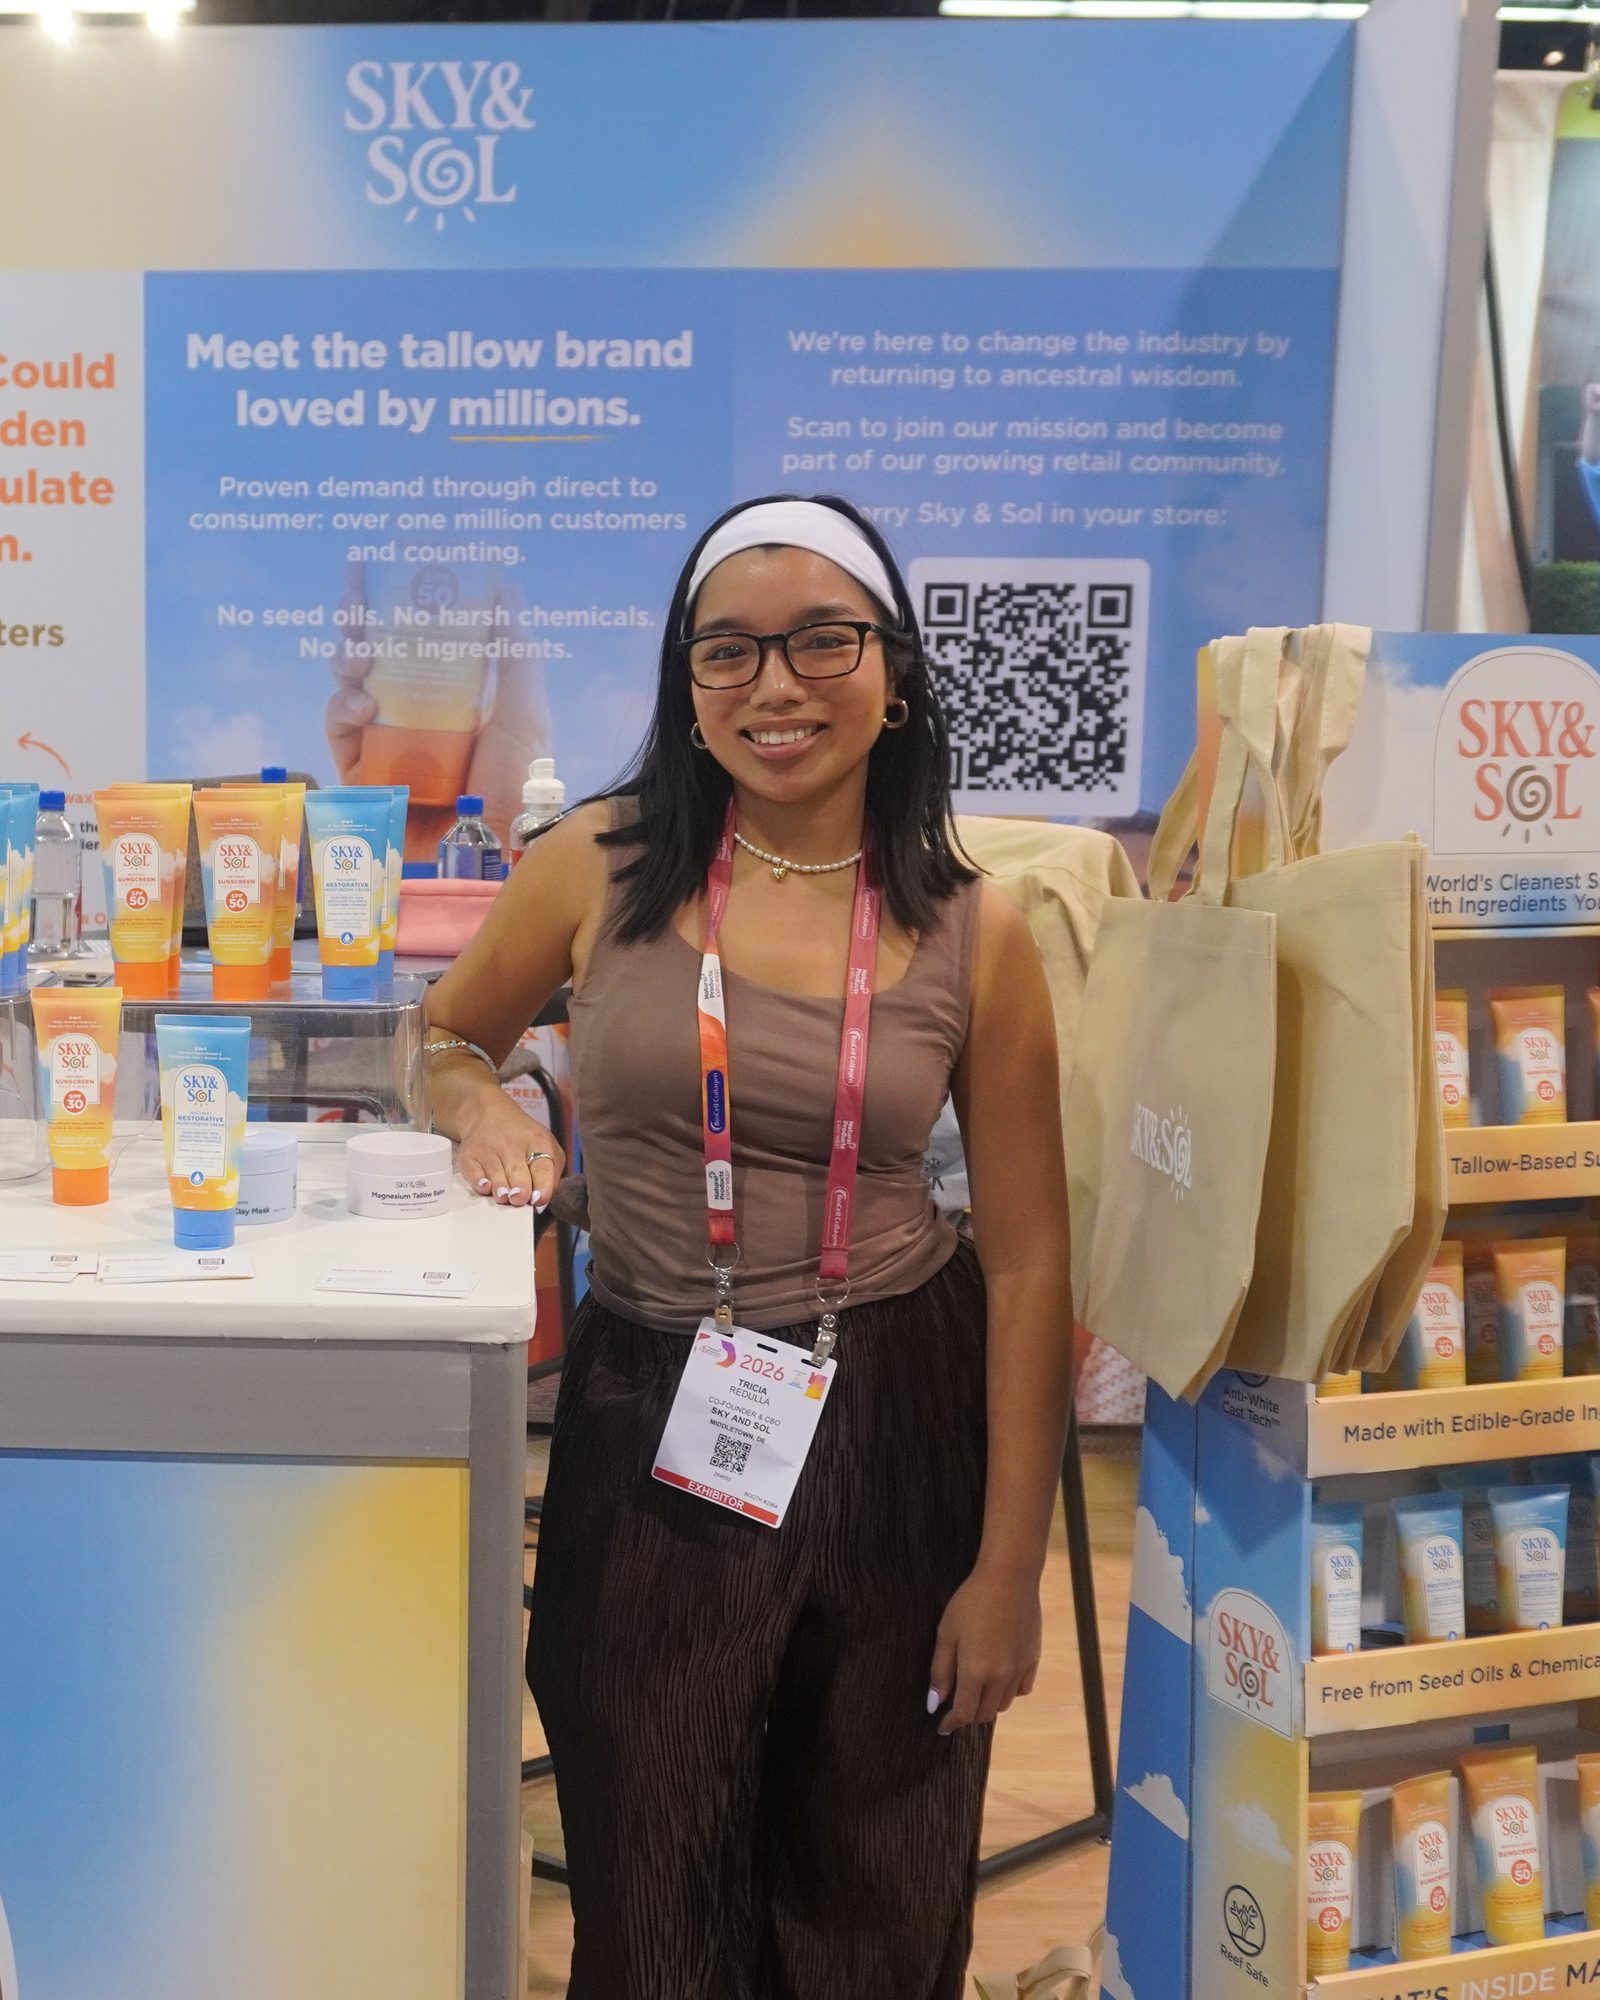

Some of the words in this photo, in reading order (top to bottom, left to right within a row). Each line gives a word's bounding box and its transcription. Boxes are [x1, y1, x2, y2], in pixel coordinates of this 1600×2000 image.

[344, 61, 535, 131] SKY&
[366, 135, 516, 207] SOL
[187, 333, 299, 369] Meet
[312, 331, 387, 369] the
[400, 331, 543, 368] tallow
[556, 330, 693, 368] brand
[789, 330, 865, 352] We're
[875, 331, 933, 351] here
[942, 332, 969, 351] to
[978, 331, 1077, 356] change
[1086, 331, 1129, 352] the
[1138, 331, 1249, 358] industry
[1257, 332, 1290, 358] by
[831, 364, 955, 388] returning
[964, 365, 992, 385] to
[1001, 364, 1121, 385] ancestral
[1131, 365, 1242, 387] wisdom.
[236, 389, 364, 426] loved
[378, 389, 436, 433] by
[449, 389, 641, 426] millions.
[788, 416, 850, 438] Scan
[860, 418, 887, 438] to
[894, 416, 944, 441] join
[954, 420, 998, 438] our
[1008, 417, 1108, 439] mission
[1117, 418, 1167, 440] and
[1175, 418, 1284, 440] become
[782, 451, 837, 474] part
[845, 450, 873, 471] of
[881, 454, 925, 471] our
[934, 450, 1044, 475] growing
[1053, 451, 1121, 471] retail
[1130, 451, 1285, 478] community.
[219, 476, 309, 497] Proven
[317, 476, 424, 497] demand
[433, 476, 536, 500] through
[545, 476, 621, 497] direct
[630, 478, 657, 497] to
[189, 511, 323, 530] consumer:
[332, 511, 389, 530] over
[397, 512, 446, 530] one
[455, 508, 542, 529] million
[550, 510, 686, 530] customers
[919, 503, 965, 528] Sky
[974, 503, 992, 524] &
[1001, 503, 1042, 524] Sol
[1052, 503, 1075, 524] in
[1083, 506, 1143, 529] your
[347, 541, 396, 562] and
[404, 541, 526, 565] counting.
[218, 604, 254, 626] No
[262, 604, 324, 626] seed
[332, 604, 384, 626] oils.
[394, 604, 431, 626] No
[439, 605, 509, 627] harsh
[518, 605, 655, 627] chemicals.
[300, 637, 337, 658] No
[344, 637, 407, 658] toxic
[417, 637, 573, 662] ingredients.
[1458, 699, 1597, 759] SKY&
[1474, 763, 1583, 822] SOL
[120, 842, 153, 855] SKY&
[220, 844, 252, 857] SKY&
[331, 845, 363, 858] SKY&
[1500, 872, 1581, 891] Cleanest
[129, 896, 146, 906] 50
[228, 898, 246, 909] 50
[1459, 895, 1567, 918] Ingredients
[57, 1043, 91, 1056] SKY&
[183, 1074, 218, 1090] SKY&
[66, 1099, 84, 1110] 30
[187, 1089, 216, 1103] SOL
[177, 1115, 224, 1123] RESTORATIVE
[1451, 1151, 1577, 1175] Tallow-Based
[371, 1191, 411, 1201] Magnesium
[251, 1206, 271, 1215] Mask
[739, 1354, 785, 1381] 2026
[729, 1385, 770, 1406] REDULLA
[739, 1378, 768, 1396] TRICIA
[1223, 1384, 1280, 1414] Anti-White
[709, 1396, 757, 1418] CO-FOUNDER
[1222, 1400, 1245, 1420] Cast
[711, 1406, 731, 1419] SKY
[731, 1414, 752, 1427] AND
[753, 1423, 771, 1435] SOL
[1344, 1422, 1397, 1443] Made
[1404, 1418, 1445, 1438] with
[1452, 1406, 1576, 1433] Edible-Grade
[687, 1480, 746, 1511] EXHIBITOR
[1218, 1612, 1280, 1674] SKY&
[1225, 1652, 1274, 1707] SOL
[1321, 1685, 1364, 1704] Free
[1370, 1680, 1413, 1698] from
[1419, 1670, 1464, 1691] Seed
[1471, 1665, 1504, 1684] Oils
[1510, 1663, 1522, 1679] &
[1495, 1806, 1529, 1822] SKY&
[1309, 1852, 1346, 1868] SKY&
[1515, 1869, 1530, 1880] 50
[1322, 1917, 1340, 1928] 50
[1220, 1943, 1243, 1969] Reef
[1246, 1962, 1269, 1988] Safe
[1460, 1967, 1555, 2000] INSIDE
